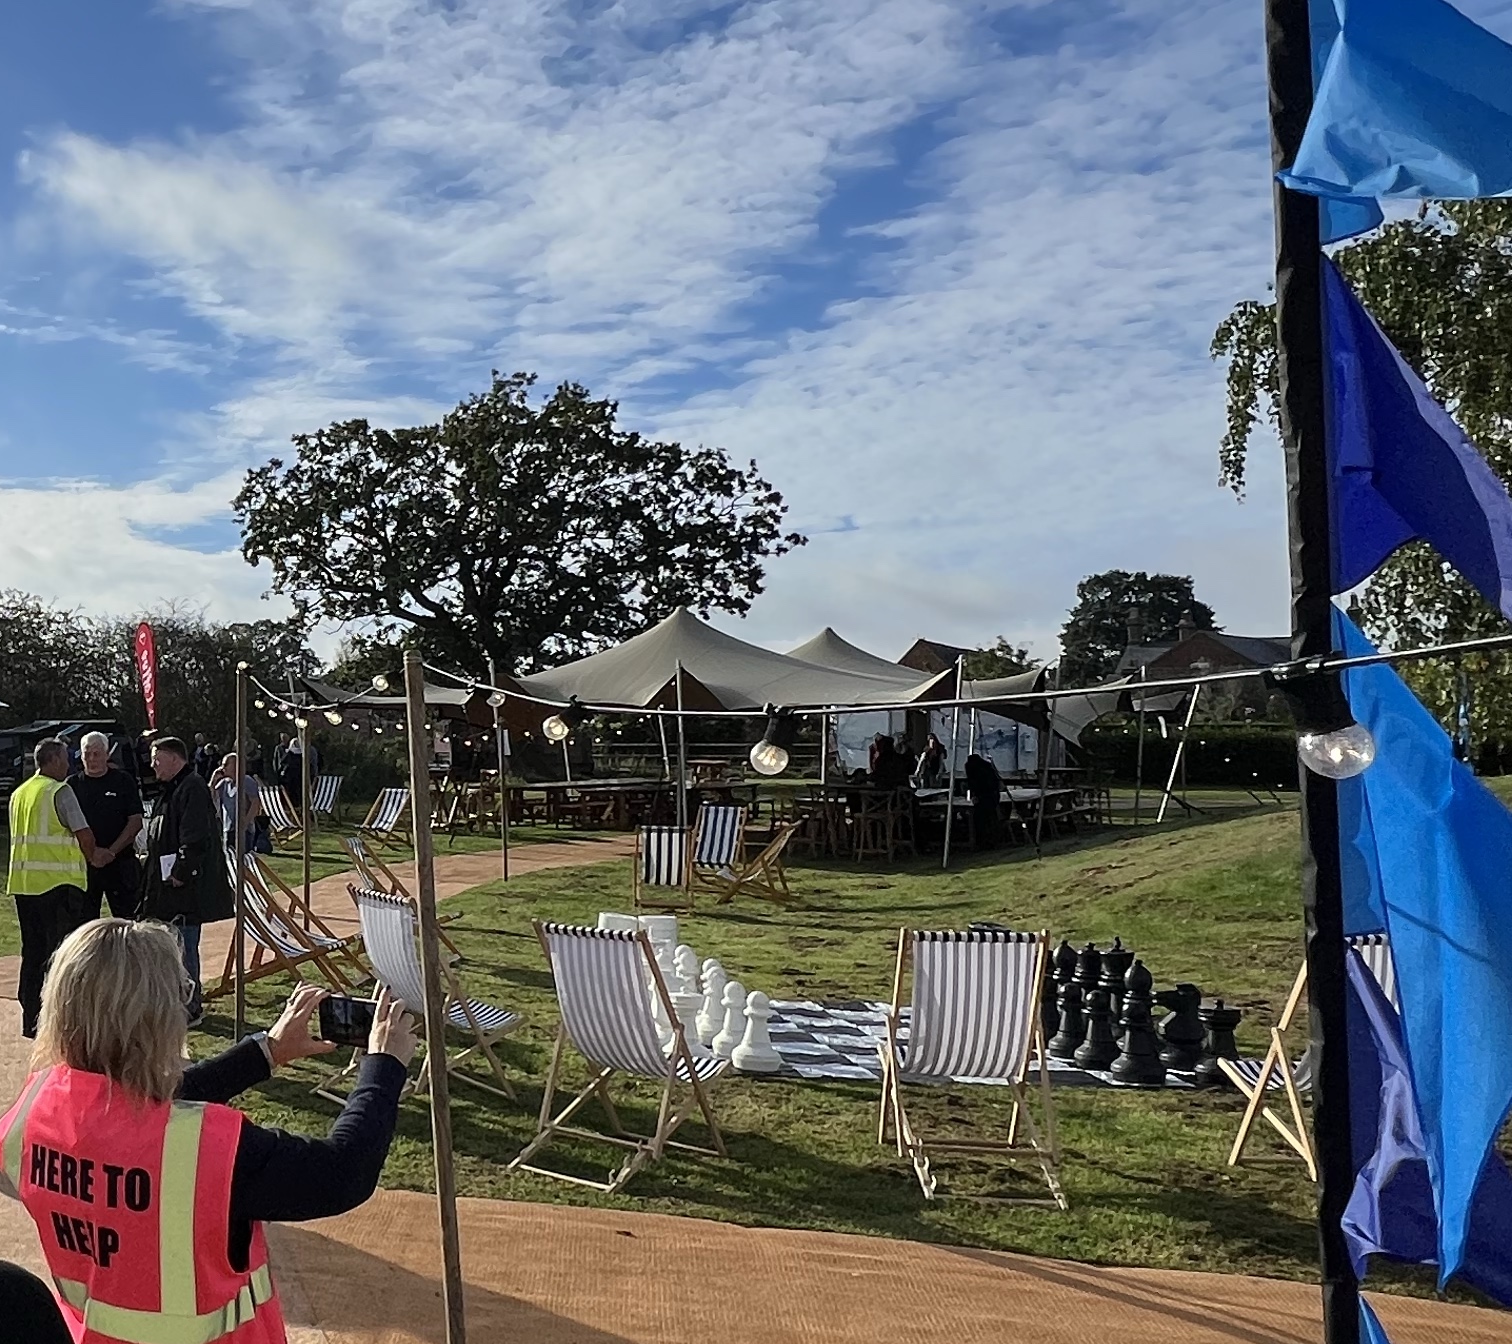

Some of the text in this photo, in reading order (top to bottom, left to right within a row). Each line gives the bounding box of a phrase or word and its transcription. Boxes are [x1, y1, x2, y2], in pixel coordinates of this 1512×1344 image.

[30, 1143, 151, 1212] HERE TO
[50, 1211, 120, 1268] HELP
